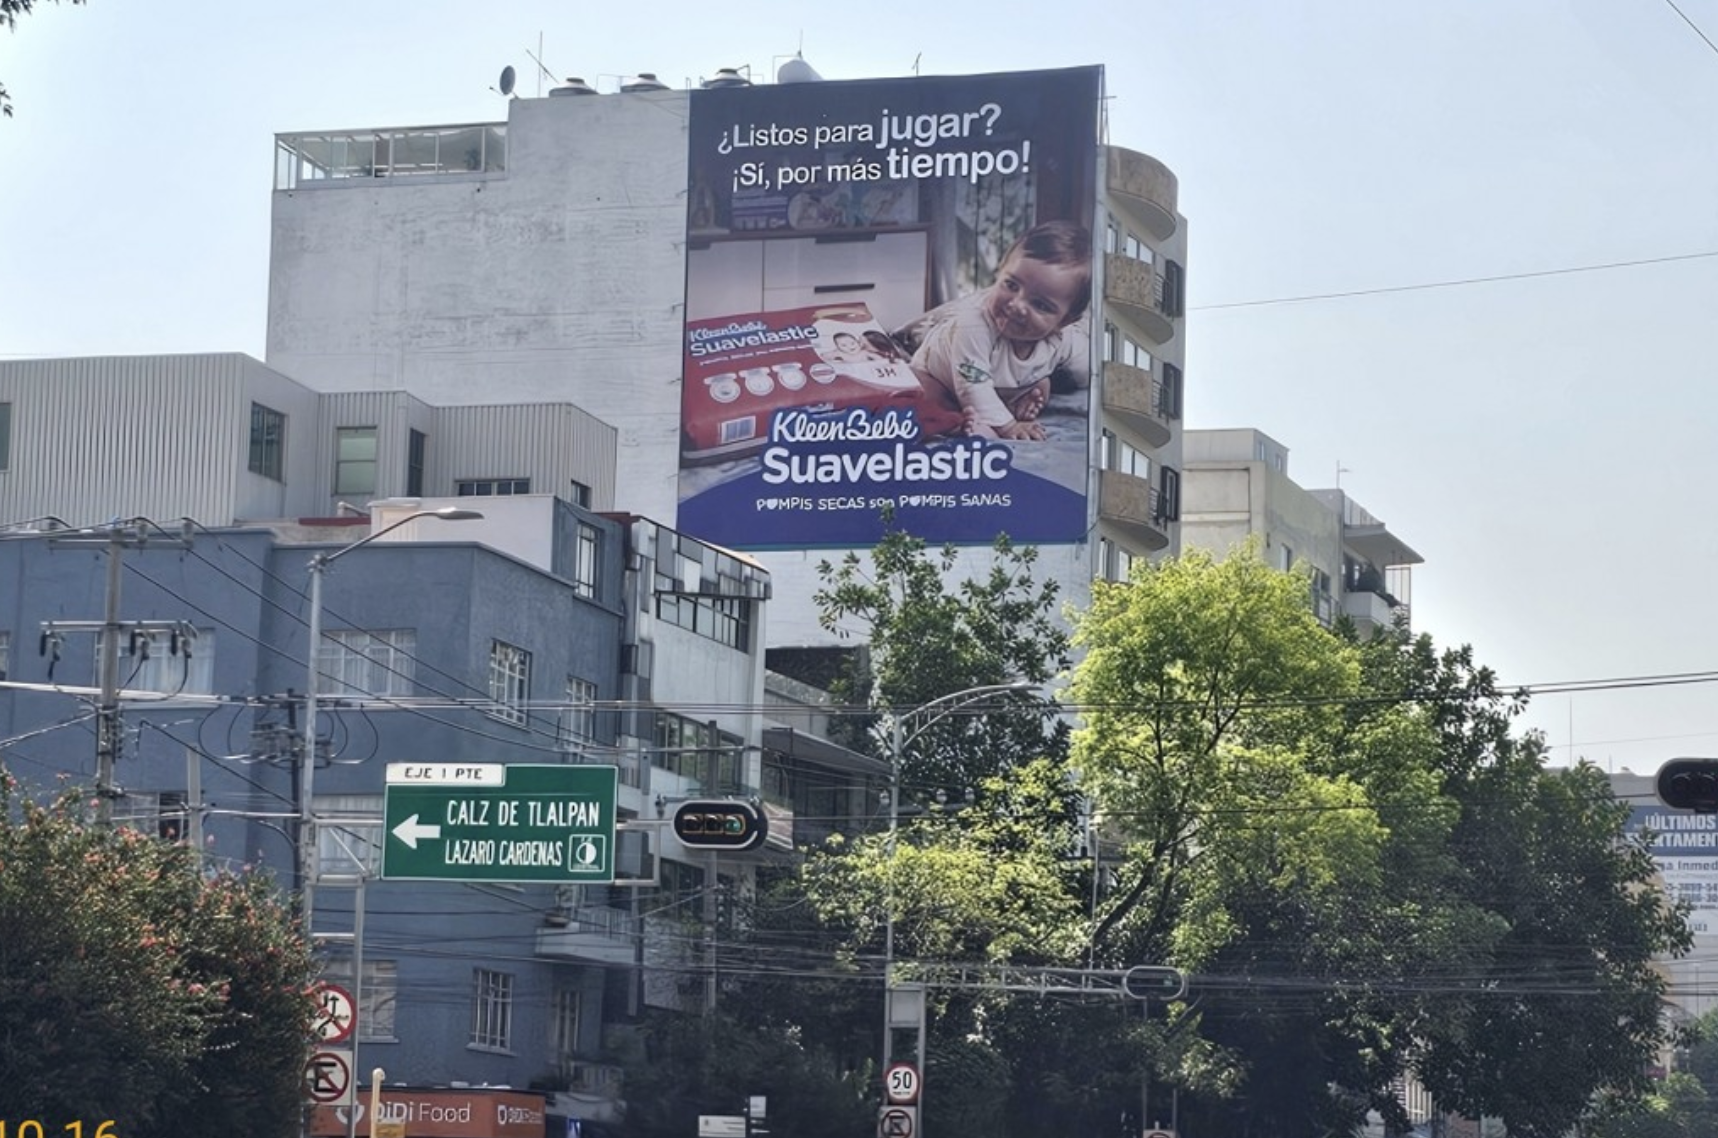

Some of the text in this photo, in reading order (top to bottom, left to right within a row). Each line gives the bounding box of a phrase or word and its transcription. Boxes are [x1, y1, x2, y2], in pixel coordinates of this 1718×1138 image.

[718, 103, 1002, 154] ¿Listos para jugar?
[733, 140, 1031, 191] ¡Sí, por más tiempo!
[690, 326, 818, 356] Suavelastic
[772, 409, 919, 442] KleenBebé
[762, 441, 1008, 484] Suavelastic
[818, 496, 865, 511] SECAS
[961, 492, 1012, 508] SANAS
[404, 767, 432, 779] EJE
[455, 767, 483, 780] PTE
[446, 800, 600, 827] CALZ DE TLALPAN
[445, 839, 563, 866] LAZARO CARDENAS
[892, 1071, 912, 1089] 50
[419, 1102, 471, 1122] Food
